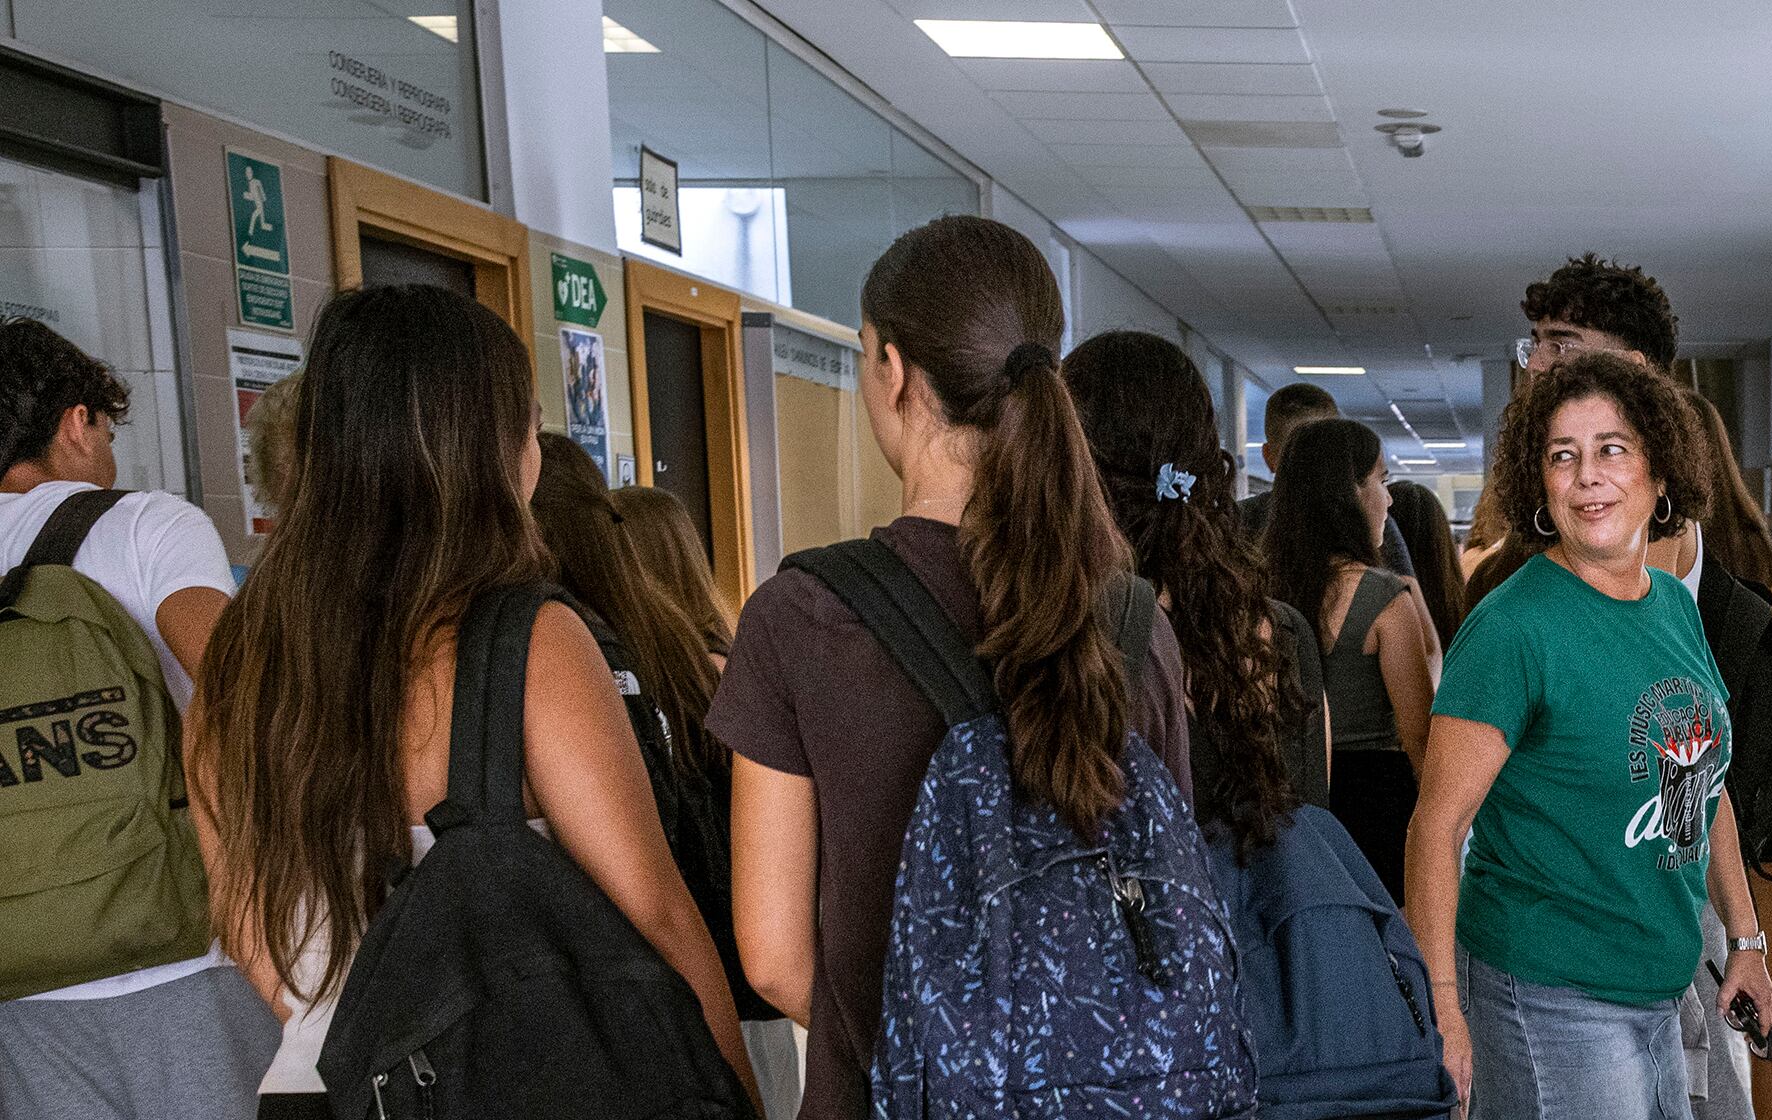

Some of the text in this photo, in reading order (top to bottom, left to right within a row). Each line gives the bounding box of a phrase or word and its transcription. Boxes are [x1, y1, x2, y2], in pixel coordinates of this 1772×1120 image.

[571, 273, 597, 312] DEA
[1627, 693, 1657, 749] MÚSIC
[1629, 751, 1650, 783] IES
